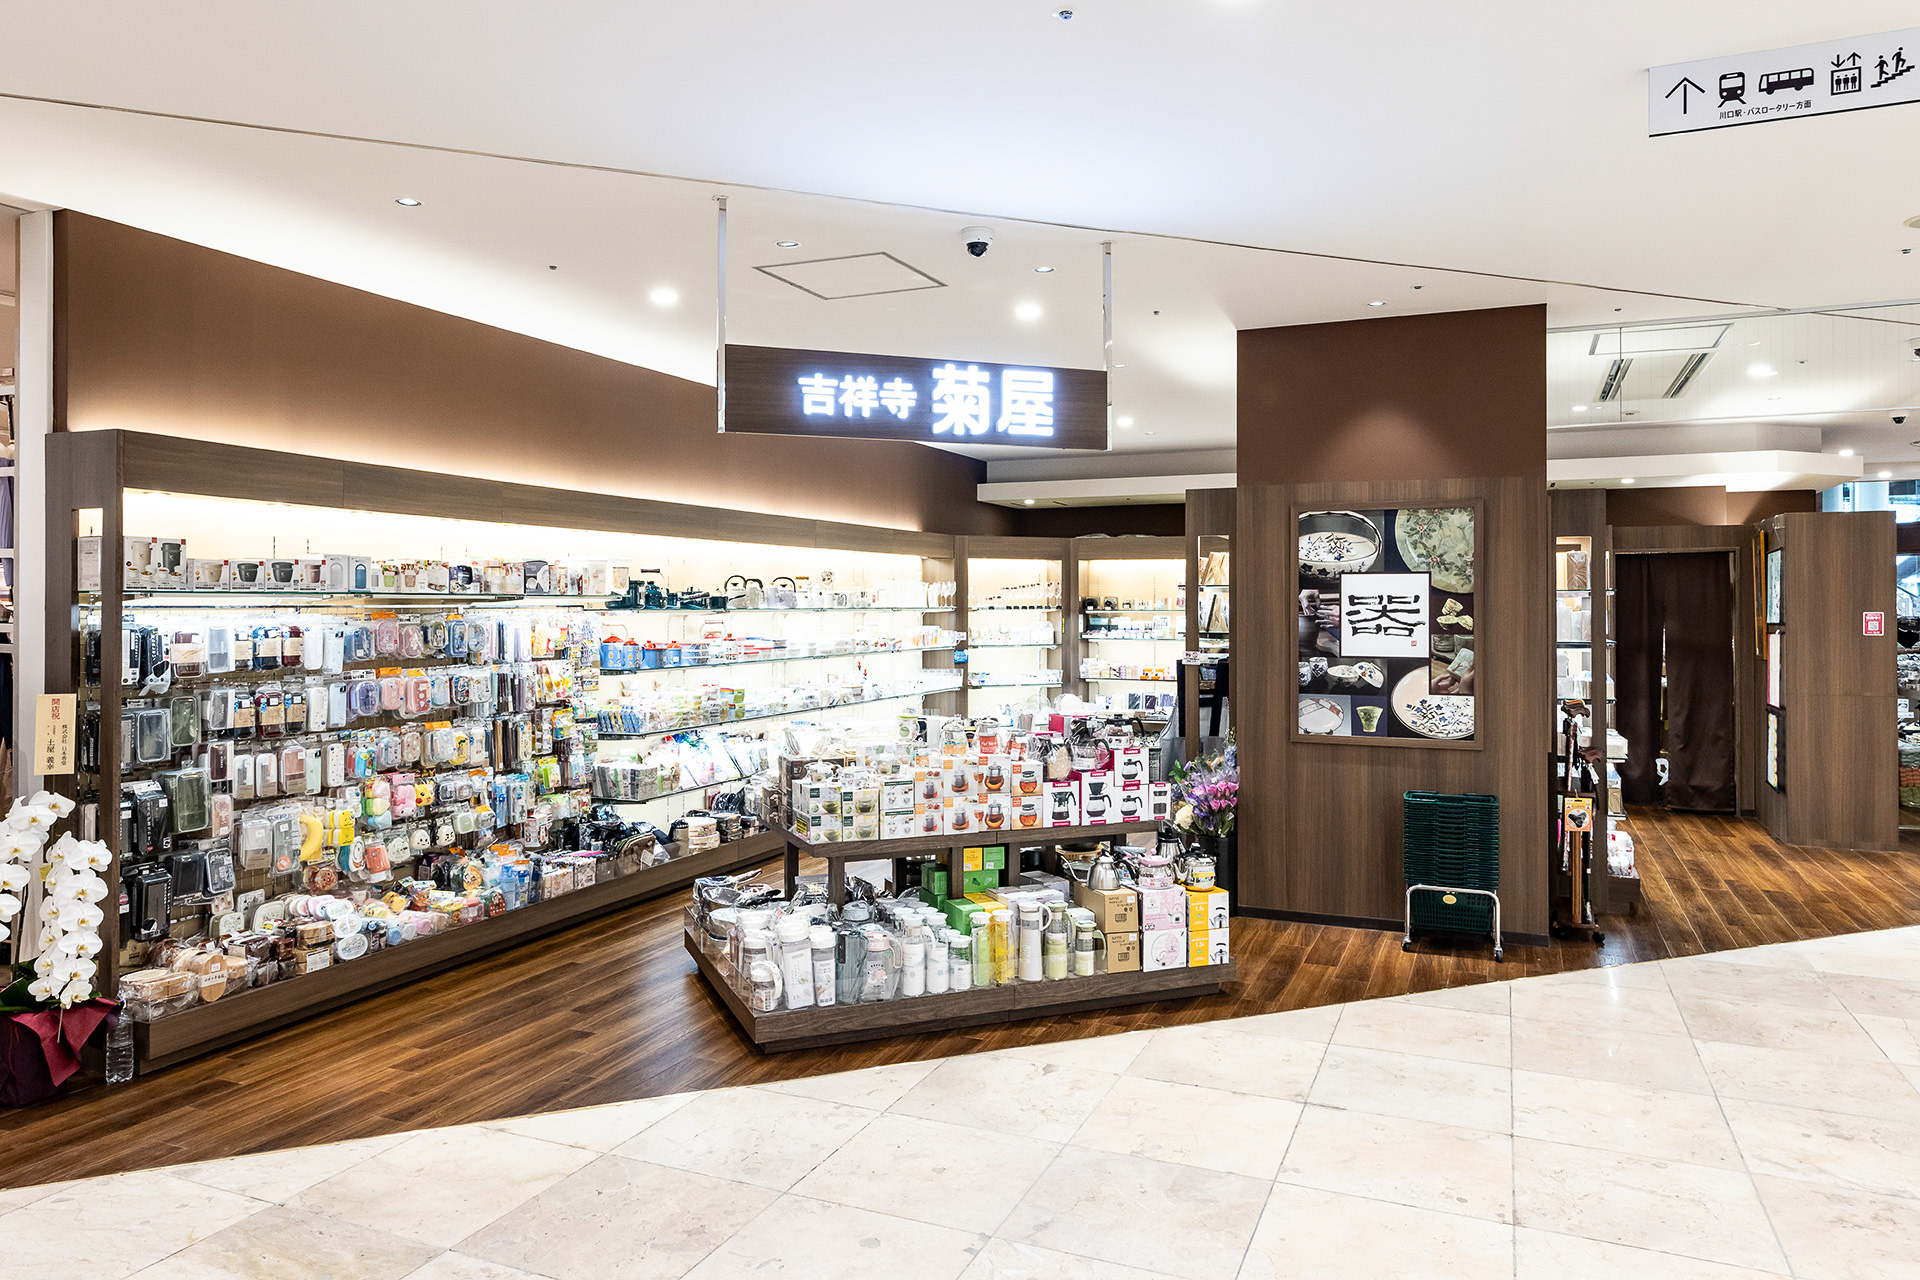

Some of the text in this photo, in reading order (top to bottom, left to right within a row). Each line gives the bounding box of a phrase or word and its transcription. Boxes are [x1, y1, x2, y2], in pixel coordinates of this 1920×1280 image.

[1720, 100, 1811, 119] 川口駅・バスロータリー方面
[798, 363, 1054, 437] 吉祥寺 菊屋
[1345, 594, 1426, 637] 器
